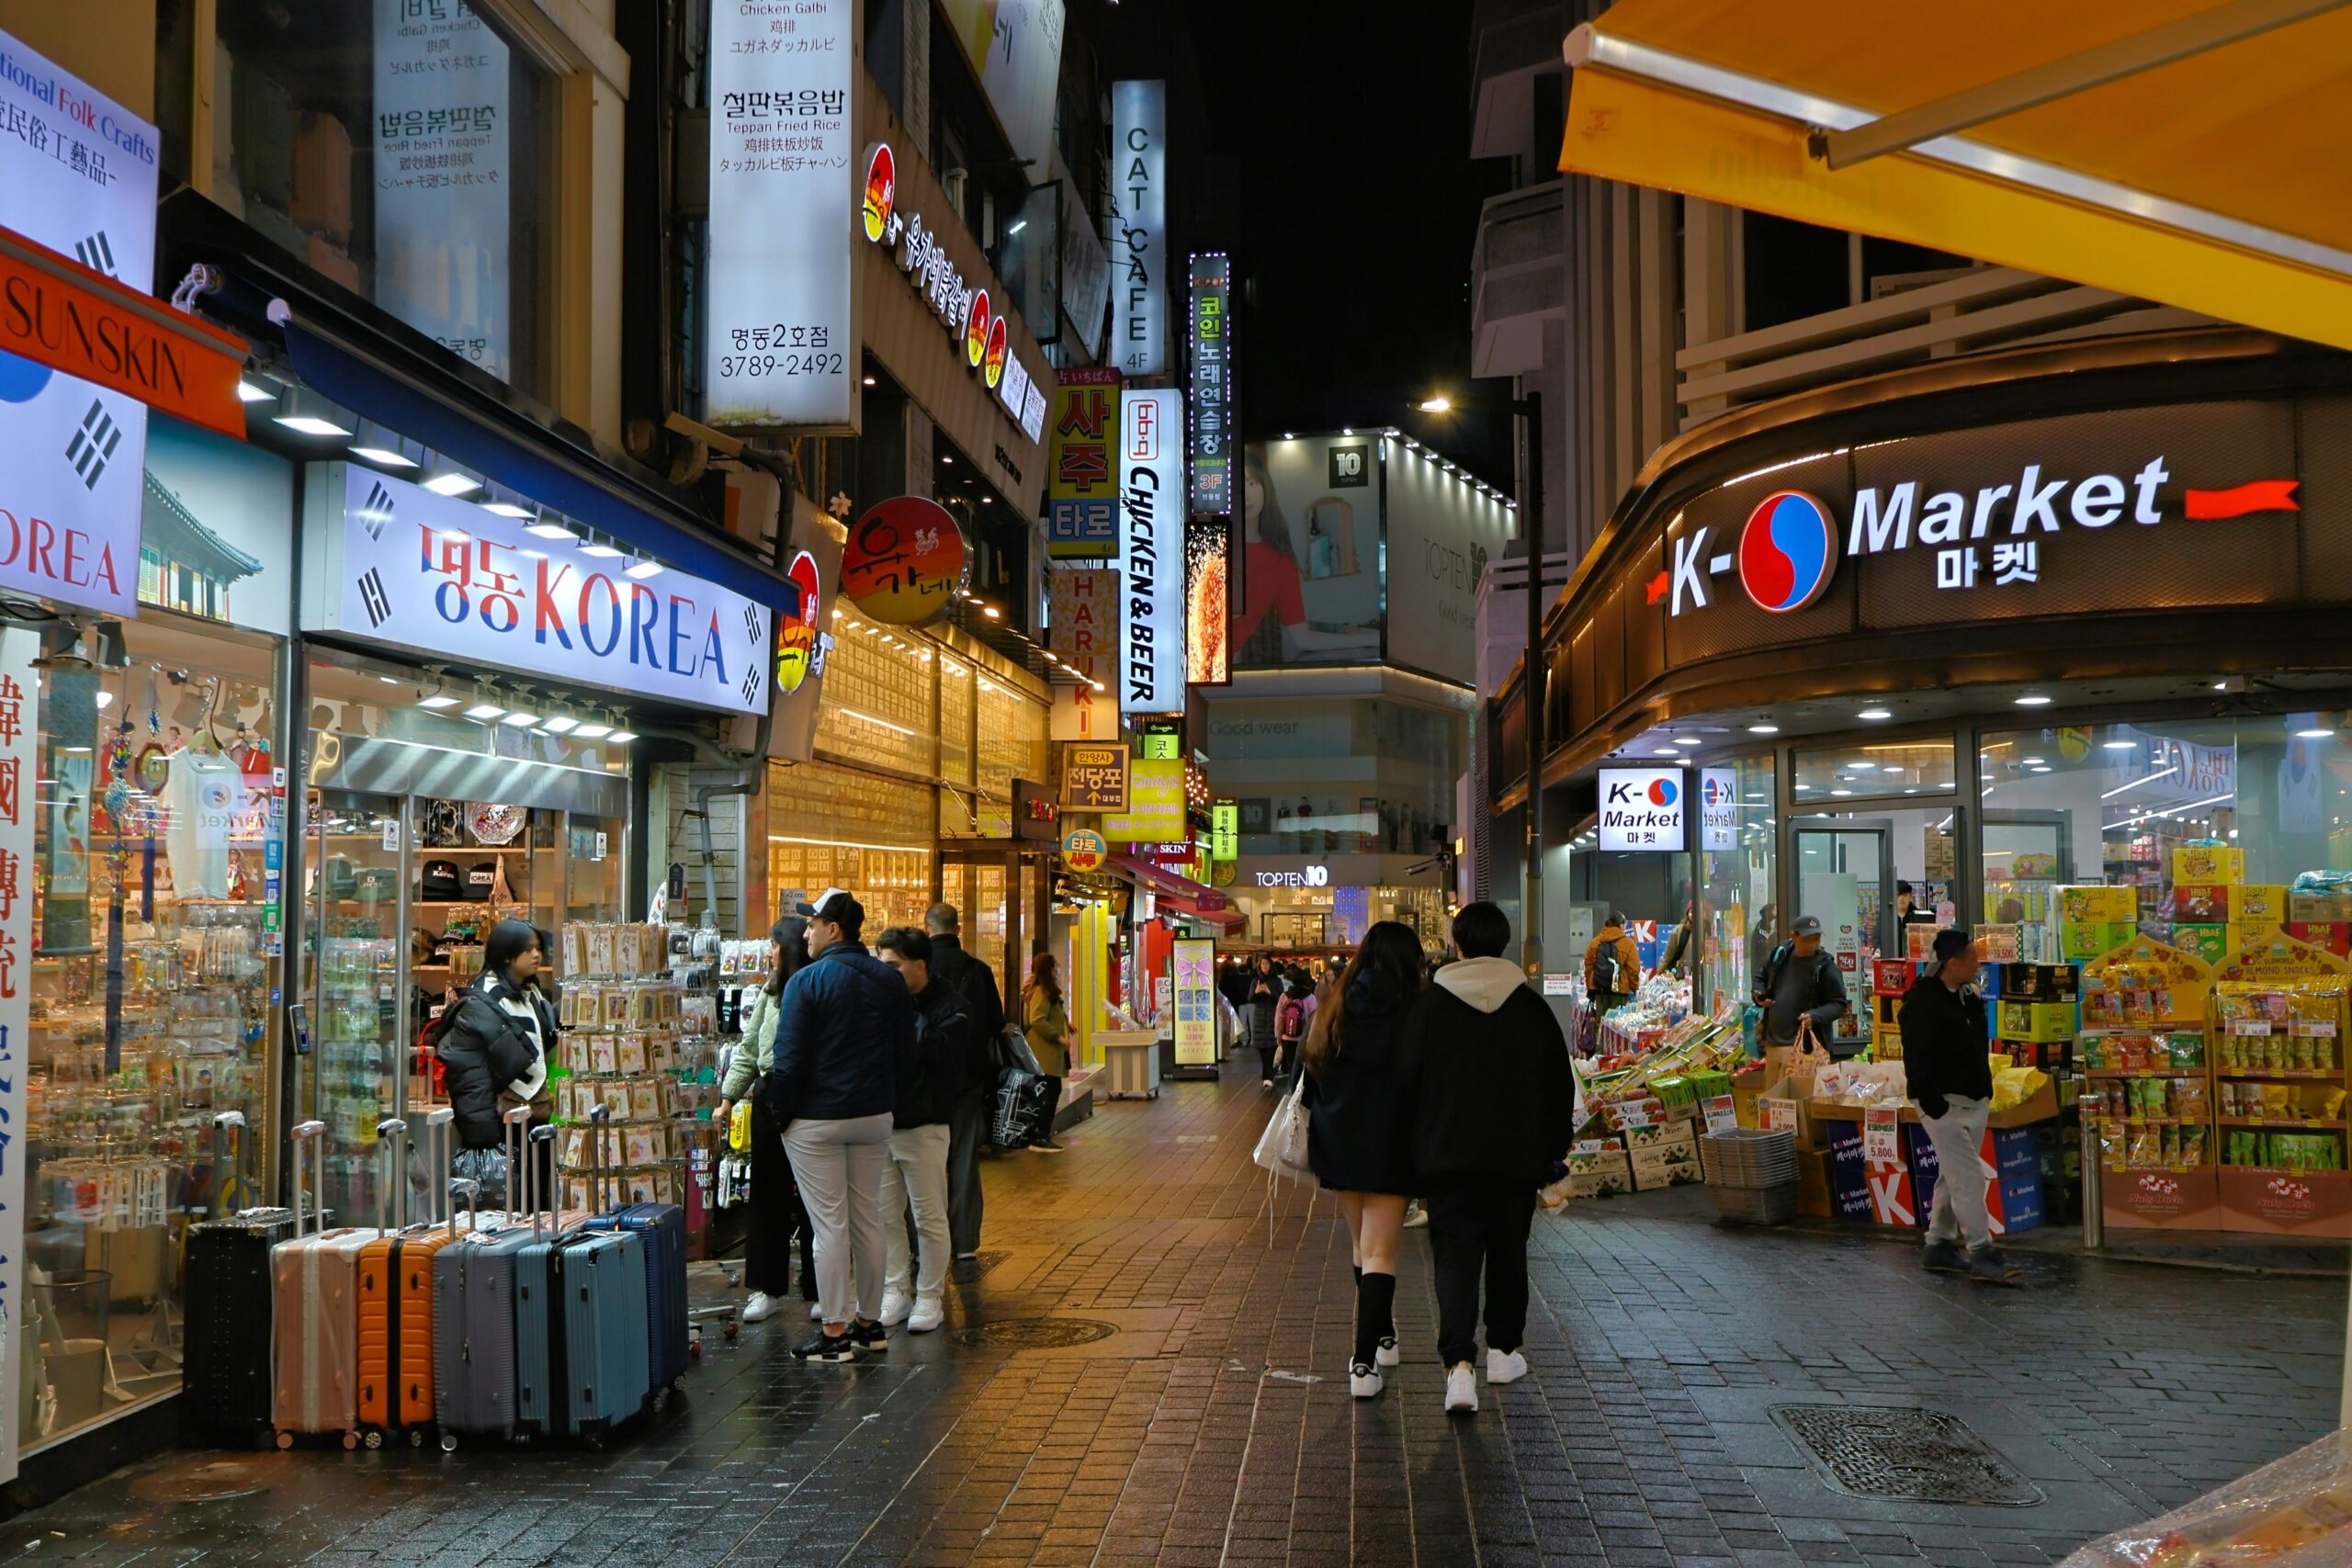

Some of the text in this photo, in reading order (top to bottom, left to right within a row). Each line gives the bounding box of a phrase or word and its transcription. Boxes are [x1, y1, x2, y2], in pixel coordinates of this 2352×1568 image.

[740, 3, 827, 17] Chicken Galbi
[770, 19, 797, 35] 鸡排
[729, 37, 837, 55] ユガネダッカルビ
[722, 89, 846, 119] 철판볶음밥
[59, 87, 97, 133] Folk
[101, 116, 155, 165] Crafts
[728, 118, 842, 136] Teppan Fried Rice
[744, 136, 824, 153] 鸡排铁板炒饭
[1126, 127, 1149, 342] CAT CAFE
[905, 213, 972, 341] 유가네닭갈비
[3, 277, 185, 399] SUNSKIN
[731, 323, 829, 352] 명동2호점
[720, 353, 843, 378] 3789-2492
[1126, 353, 1148, 368] 4F
[1057, 389, 1111, 493] 사주
[1336, 452, 1361, 478] 10
[1200, 474, 1223, 490] 3F
[1847, 455, 2171, 558] Market
[1056, 502, 1114, 537] 타로
[847, 515, 953, 594] 유가네
[1936, 538, 2042, 591] 마켓
[1073, 576, 1095, 734] HARUKI
[1209, 720, 1300, 737] Good wear
[1069, 767, 1123, 791] 전당포
[1604, 811, 1679, 828] Market
[1070, 837, 1097, 852] 타로
[1159, 845, 1187, 853] SKIN
[1626, 831, 1657, 844] 마켓
[1069, 852, 1096, 867] 사주
[1634, 919, 1656, 943] K
[2245, 965, 2315, 976] ALMOND SNACKS
[2264, 957, 2295, 966] FLAVORED
[1870, 1172, 1916, 1224] K
